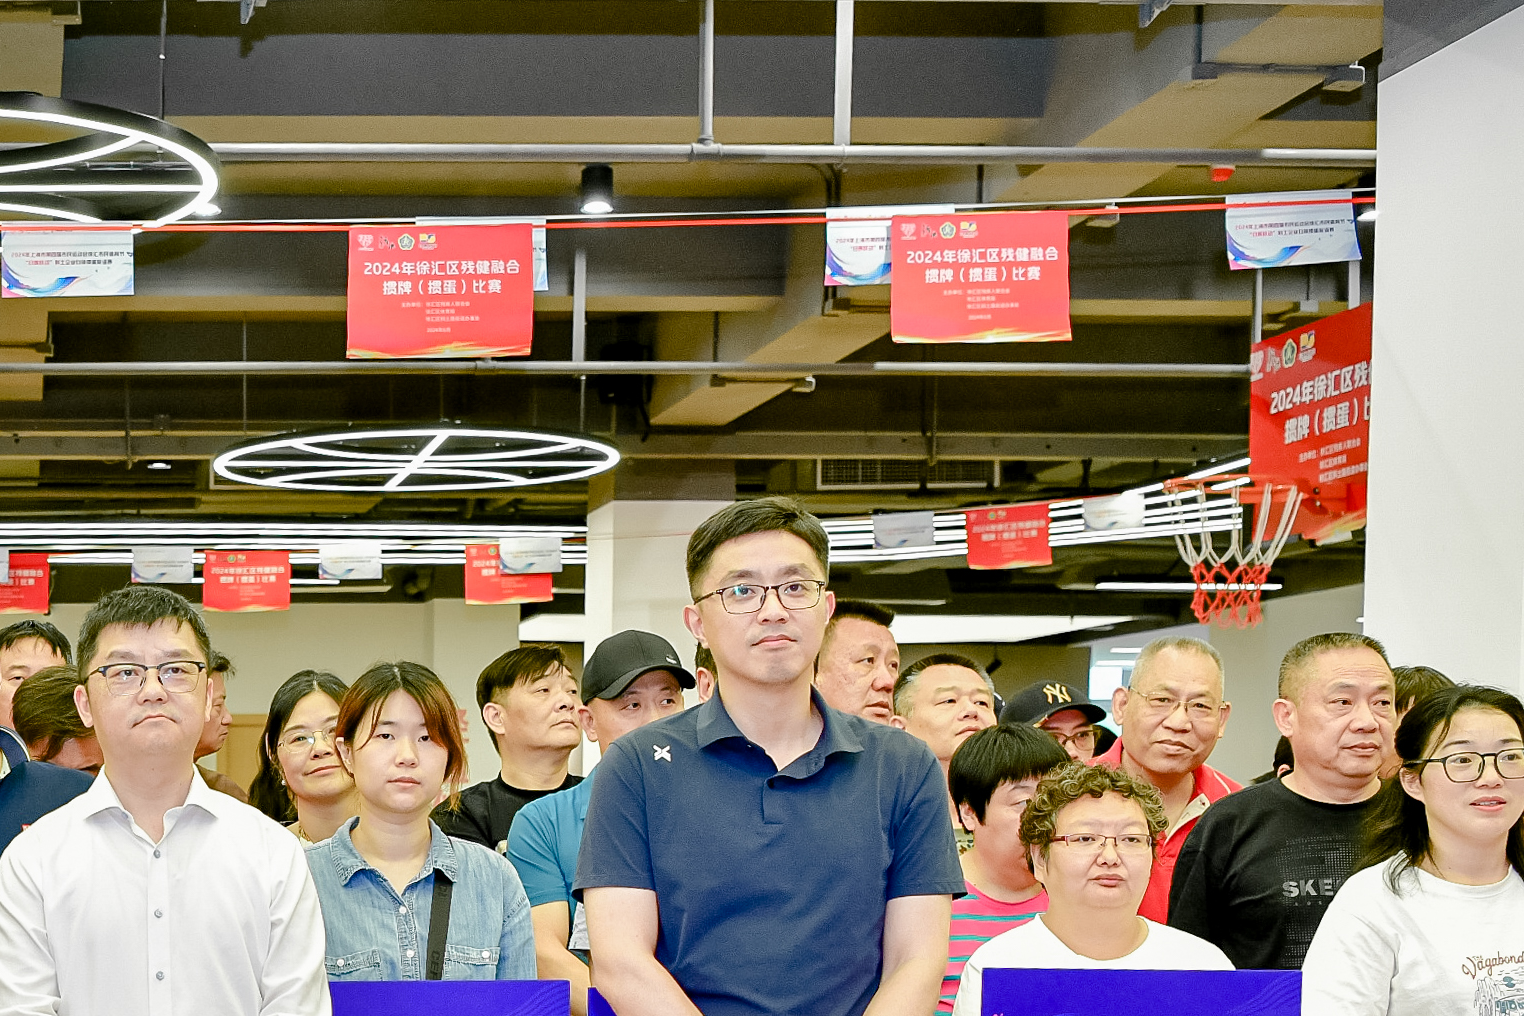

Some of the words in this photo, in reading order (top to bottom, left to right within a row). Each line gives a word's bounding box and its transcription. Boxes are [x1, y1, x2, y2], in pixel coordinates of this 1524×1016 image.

[906, 246, 1059, 264] 2024年徐汇区残健融合
[363, 260, 520, 276] 2024年徐汇区残健融合
[925, 266, 1041, 284] 掼牌（掼蛋）比赛
[382, 279, 502, 296] 掼牌（掼蛋）比赛
